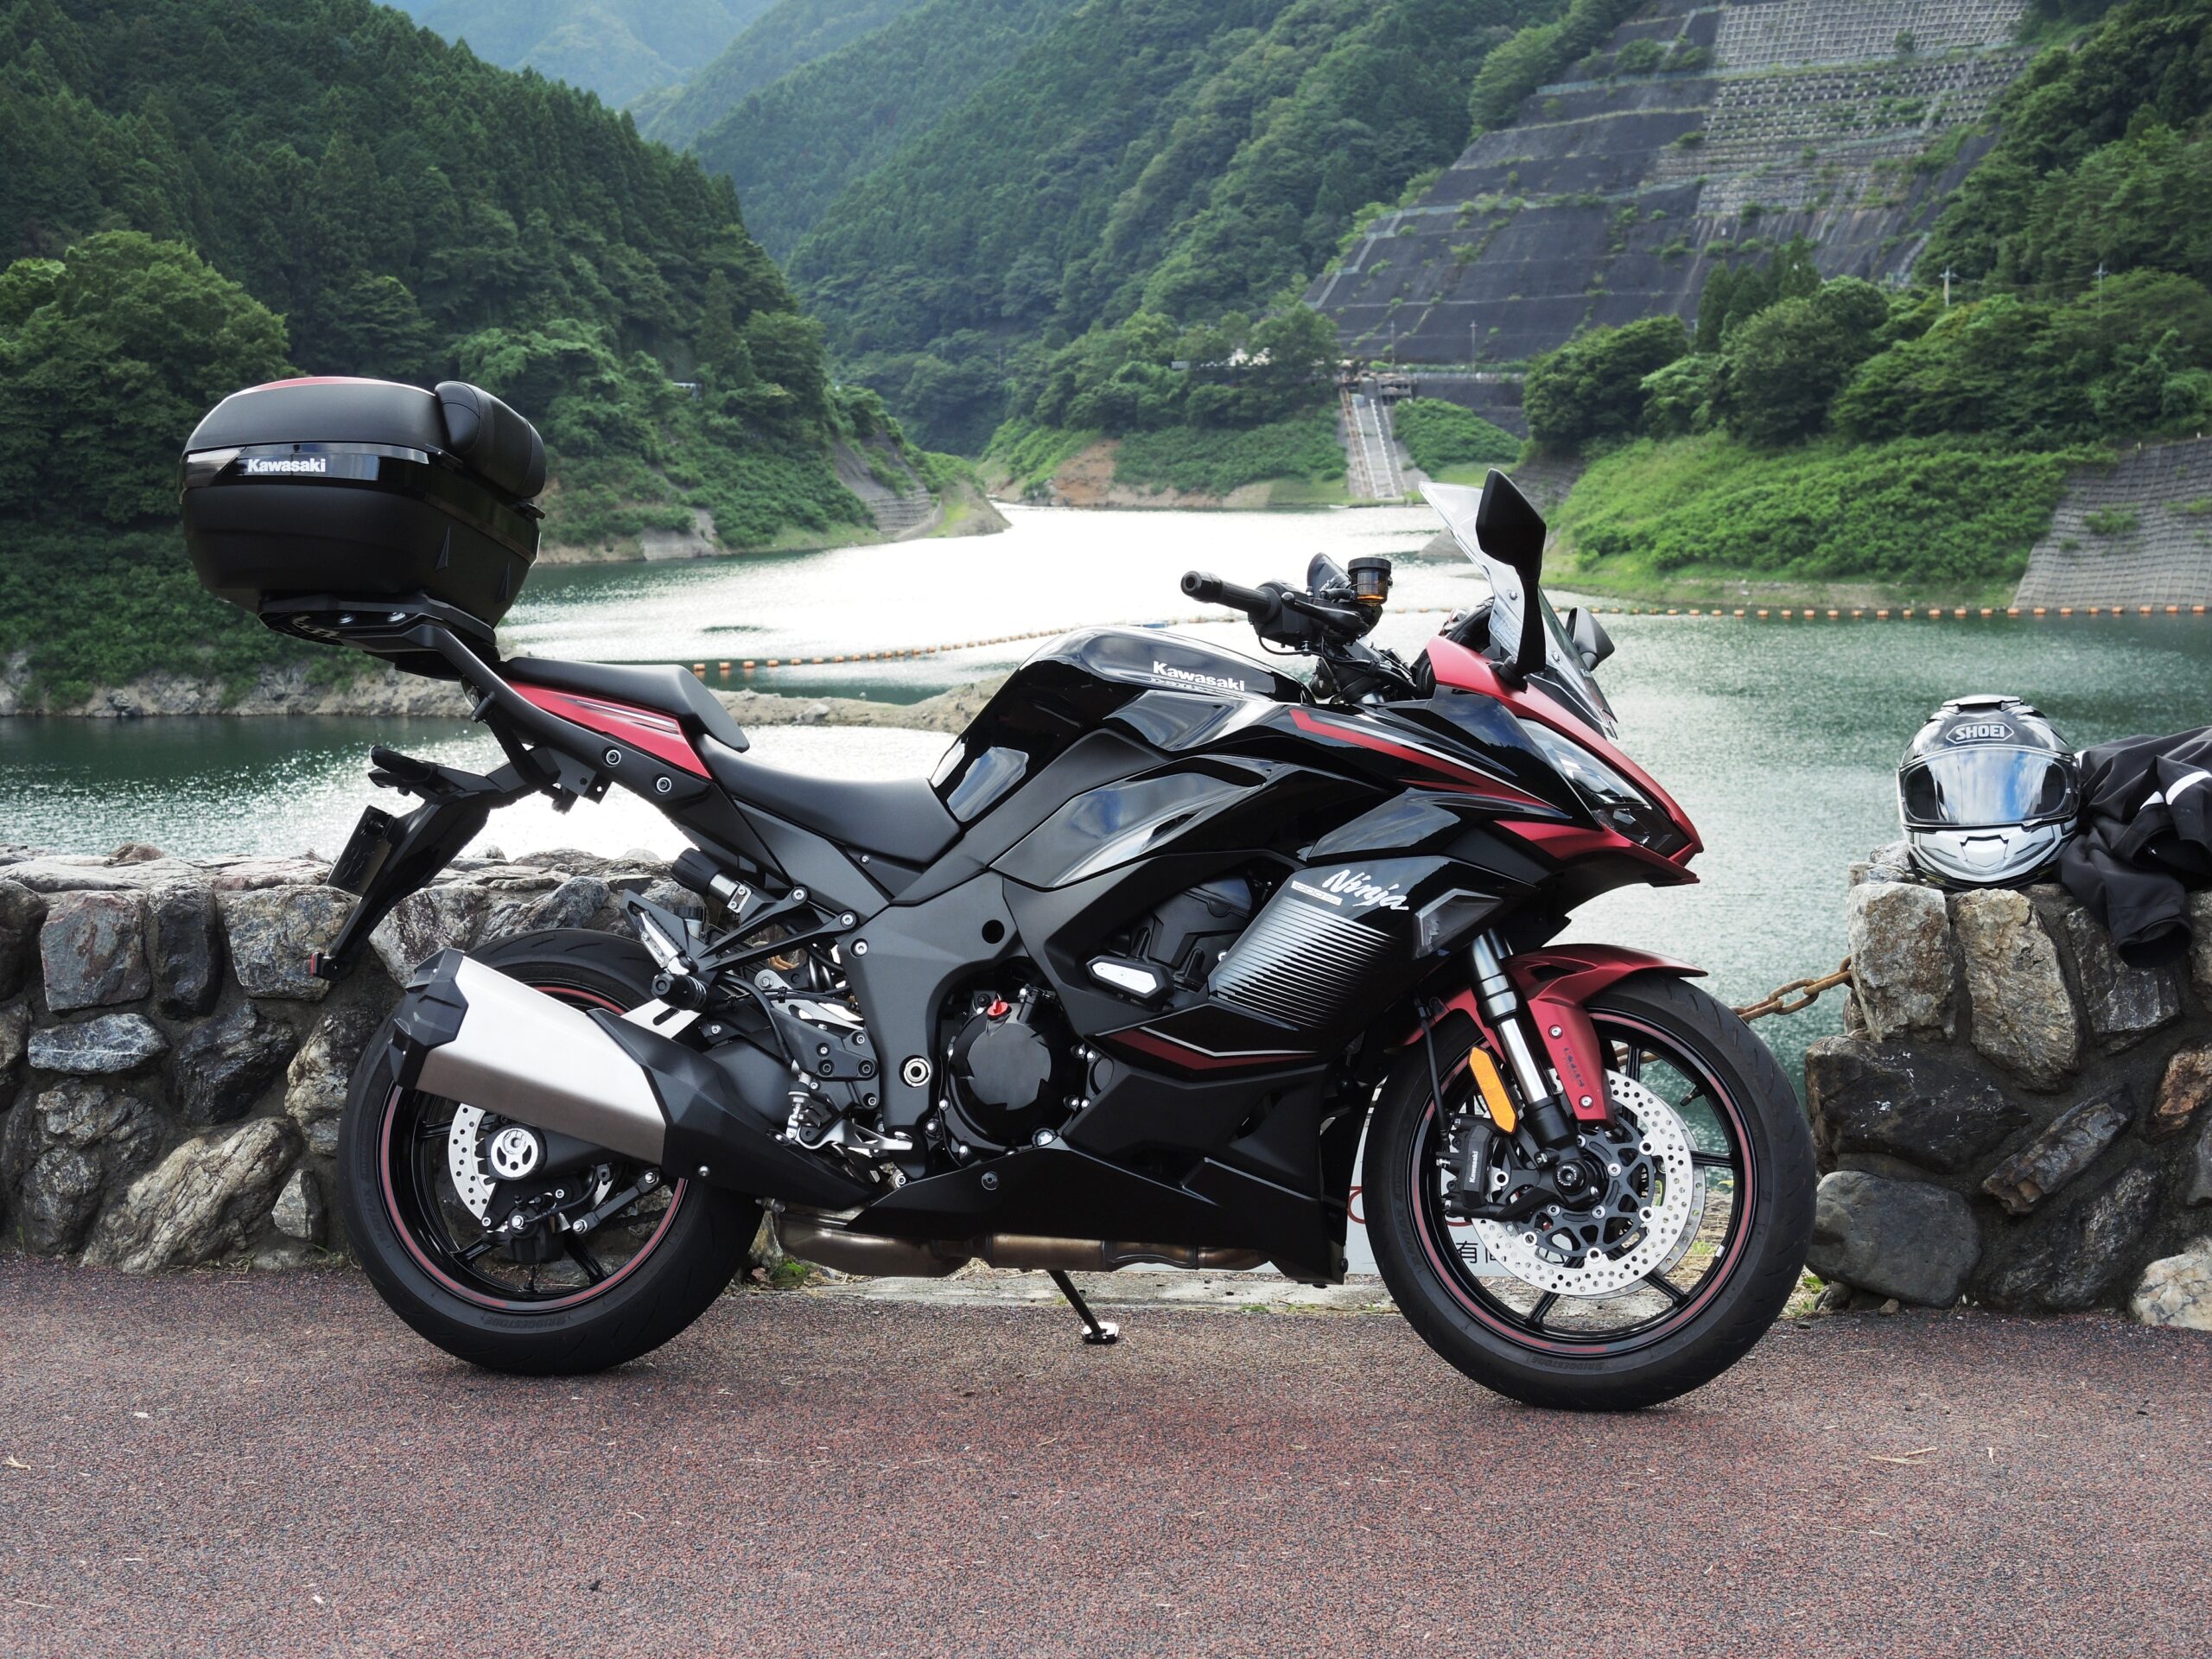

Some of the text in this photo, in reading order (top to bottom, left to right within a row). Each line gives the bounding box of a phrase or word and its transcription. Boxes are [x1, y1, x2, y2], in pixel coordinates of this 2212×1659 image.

[247, 458, 327, 473] Kawasaki
[1153, 661, 1245, 691] Kawasaki
[1955, 725, 2005, 741] SHOEI
[1321, 868, 1410, 911] Ninja
